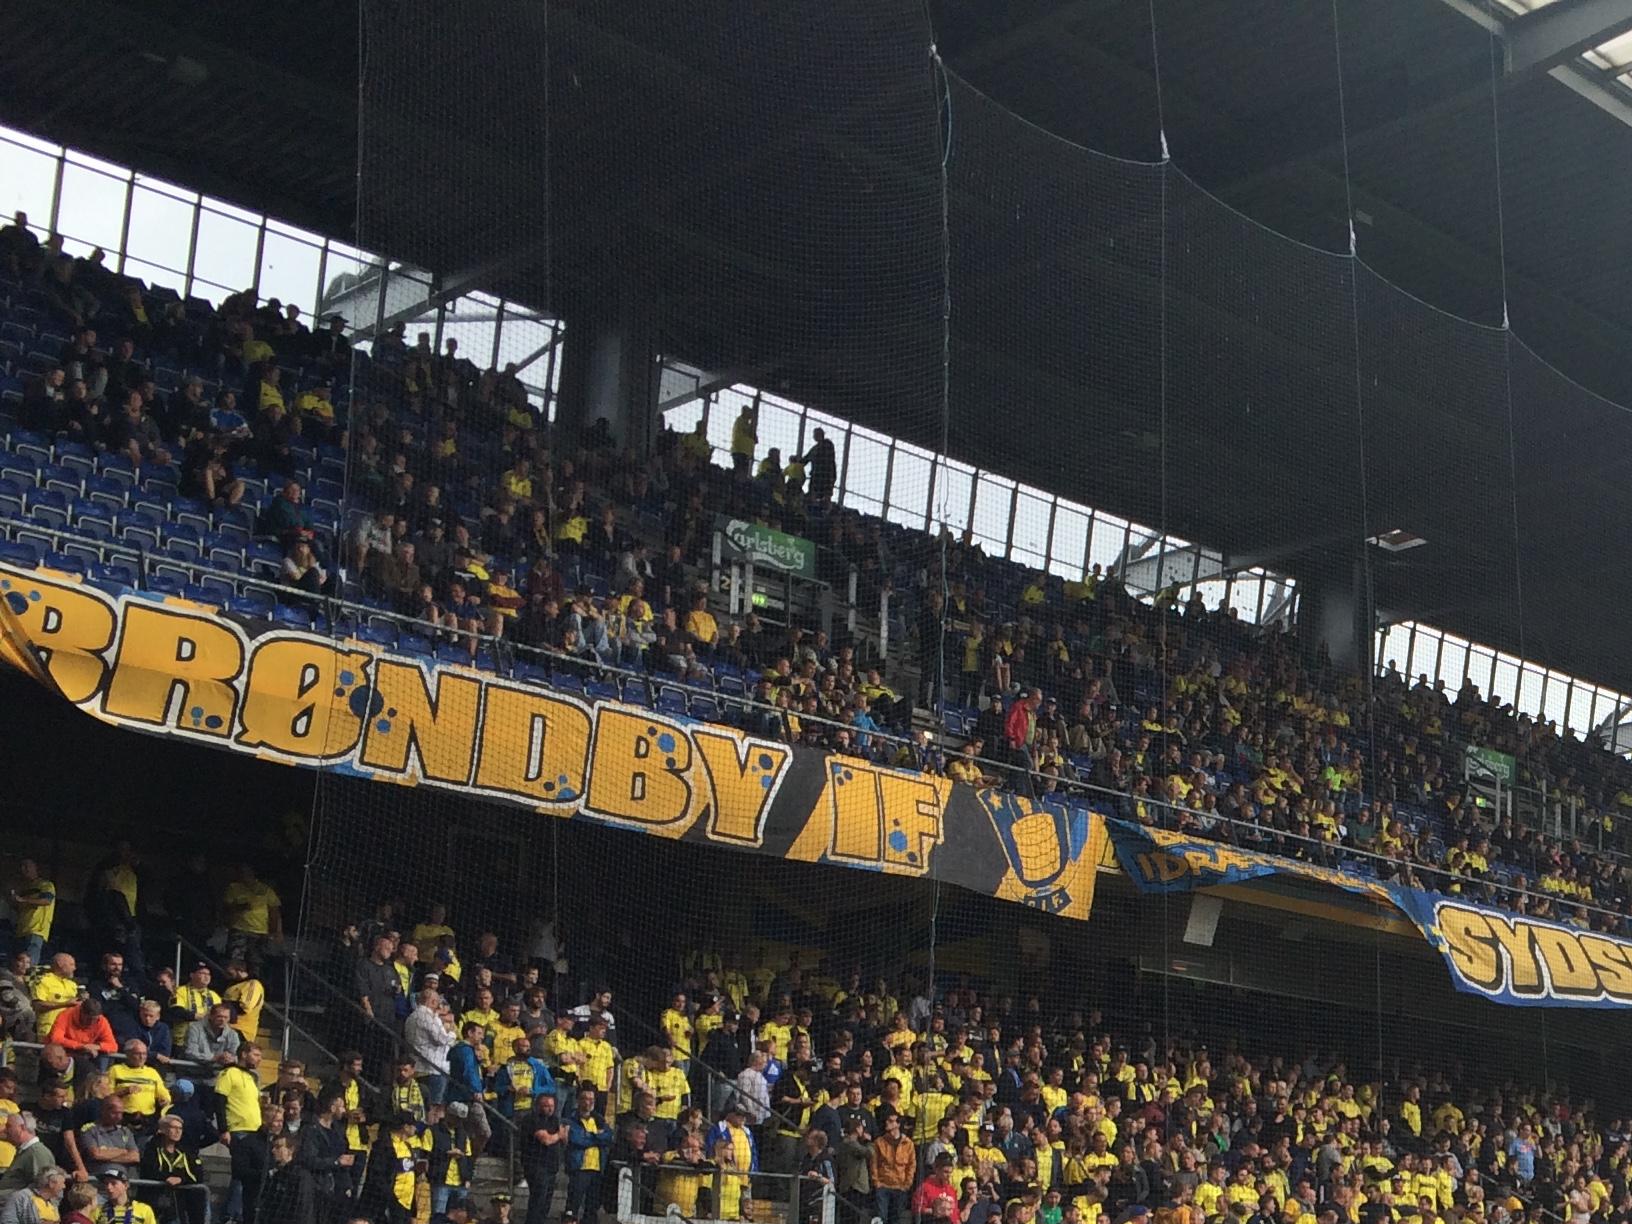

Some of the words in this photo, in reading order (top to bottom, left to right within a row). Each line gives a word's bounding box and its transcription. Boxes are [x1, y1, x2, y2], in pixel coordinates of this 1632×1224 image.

[726, 519, 804, 570] Carlsberg
[0, 566, 794, 848] BRØNDBY
[824, 755, 945, 877] IF
